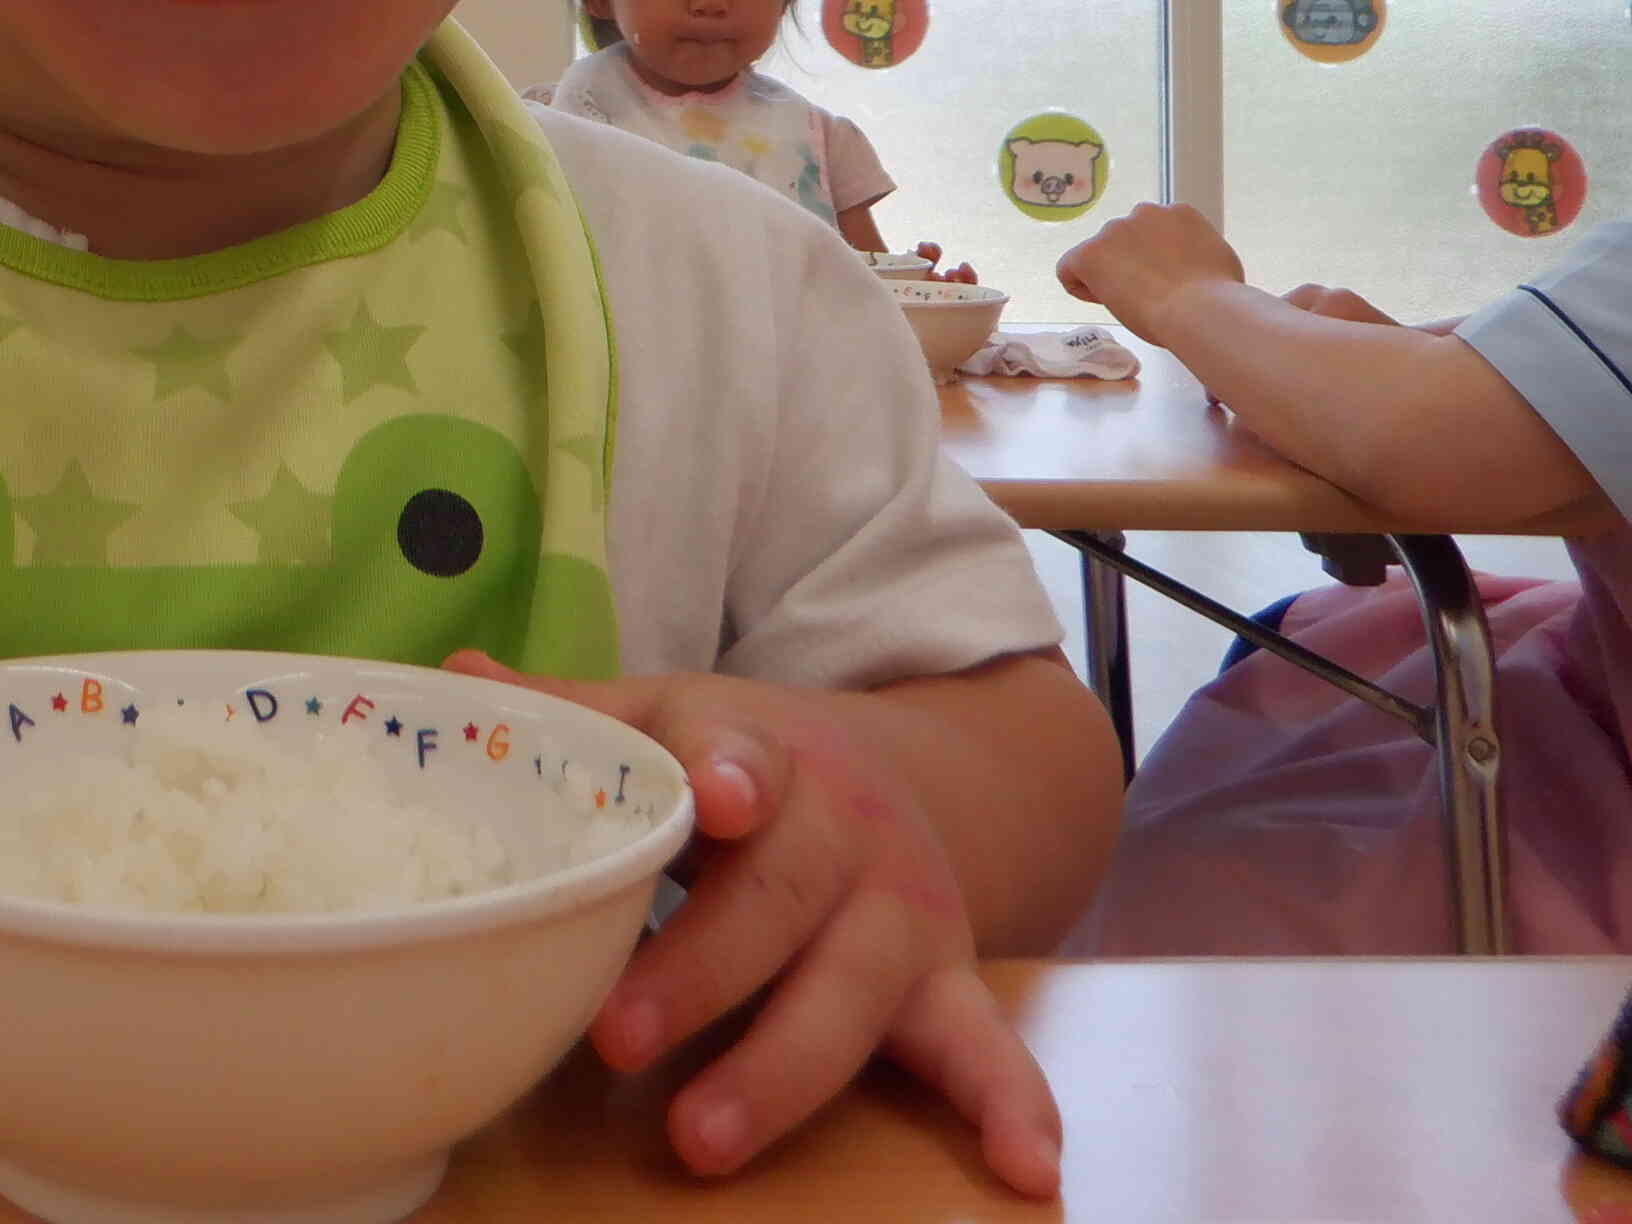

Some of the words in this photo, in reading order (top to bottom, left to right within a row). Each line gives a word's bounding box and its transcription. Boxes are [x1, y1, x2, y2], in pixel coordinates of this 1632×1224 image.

[8, 702, 35, 742] A
[80, 678, 104, 713] B
[246, 688, 277, 723] D
[416, 728, 438, 769] F
[485, 722, 511, 762] G
